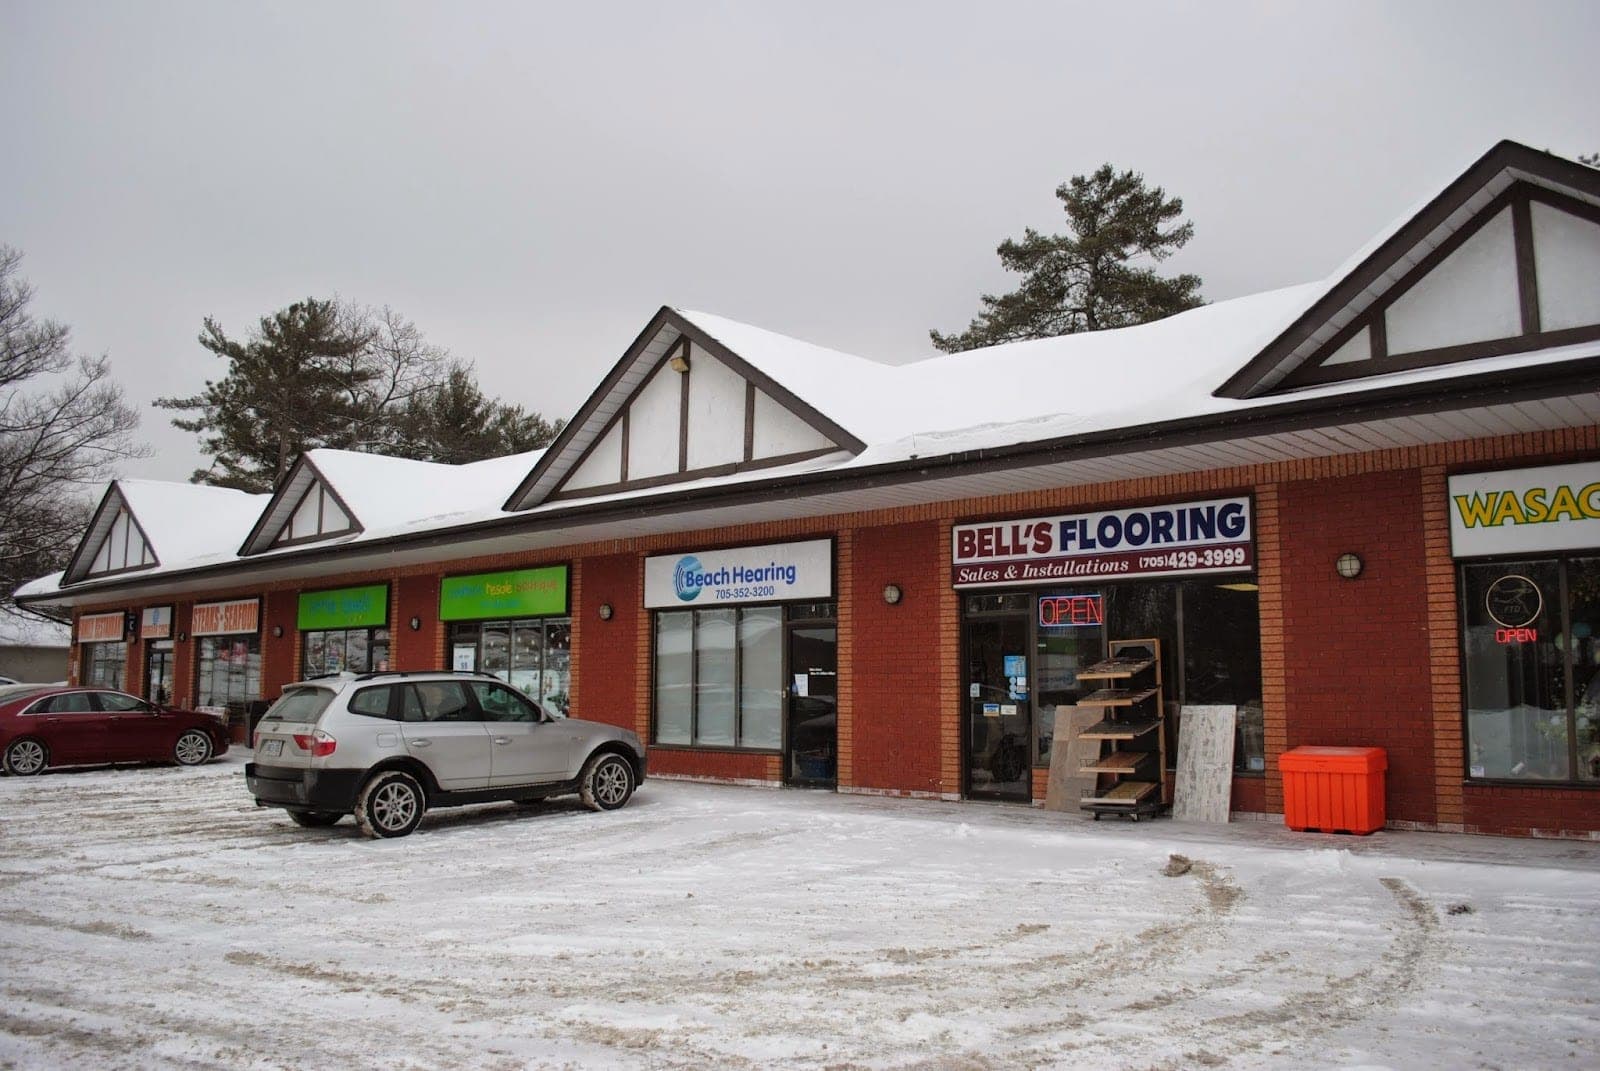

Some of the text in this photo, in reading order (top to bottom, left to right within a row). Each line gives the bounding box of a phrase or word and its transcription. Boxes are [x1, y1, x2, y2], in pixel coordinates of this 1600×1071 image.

[957, 502, 1246, 559] BELL'S FLOORING
[686, 562, 796, 588] Beach Hearing
[958, 567, 999, 583] Sales
[1004, 565, 1018, 580] &
[1022, 558, 1129, 578] Installations
[716, 585, 775, 600] 705-352-3200
[1041, 597, 1104, 625] OPEN
[1495, 628, 1537, 643] OPEN
